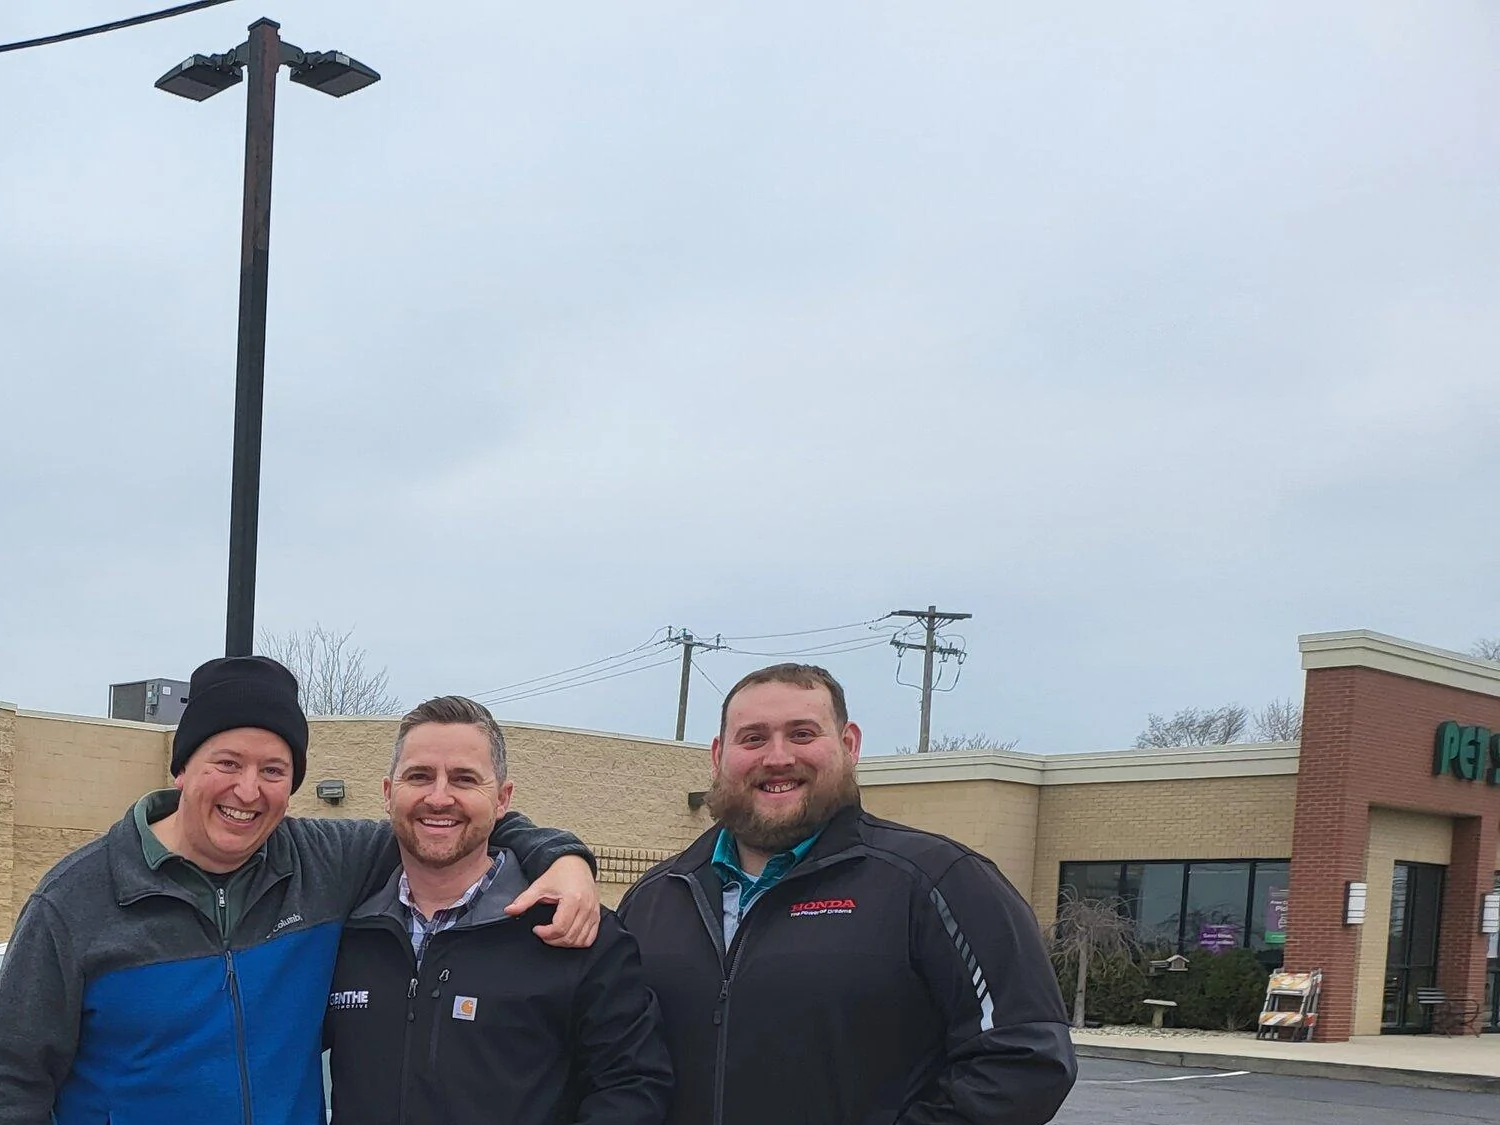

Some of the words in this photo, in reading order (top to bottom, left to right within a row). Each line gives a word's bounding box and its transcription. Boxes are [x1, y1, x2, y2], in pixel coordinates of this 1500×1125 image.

[791, 899, 856, 912] HONDA
[273, 913, 304, 932] Columb
[330, 991, 369, 1005] GENTHE
